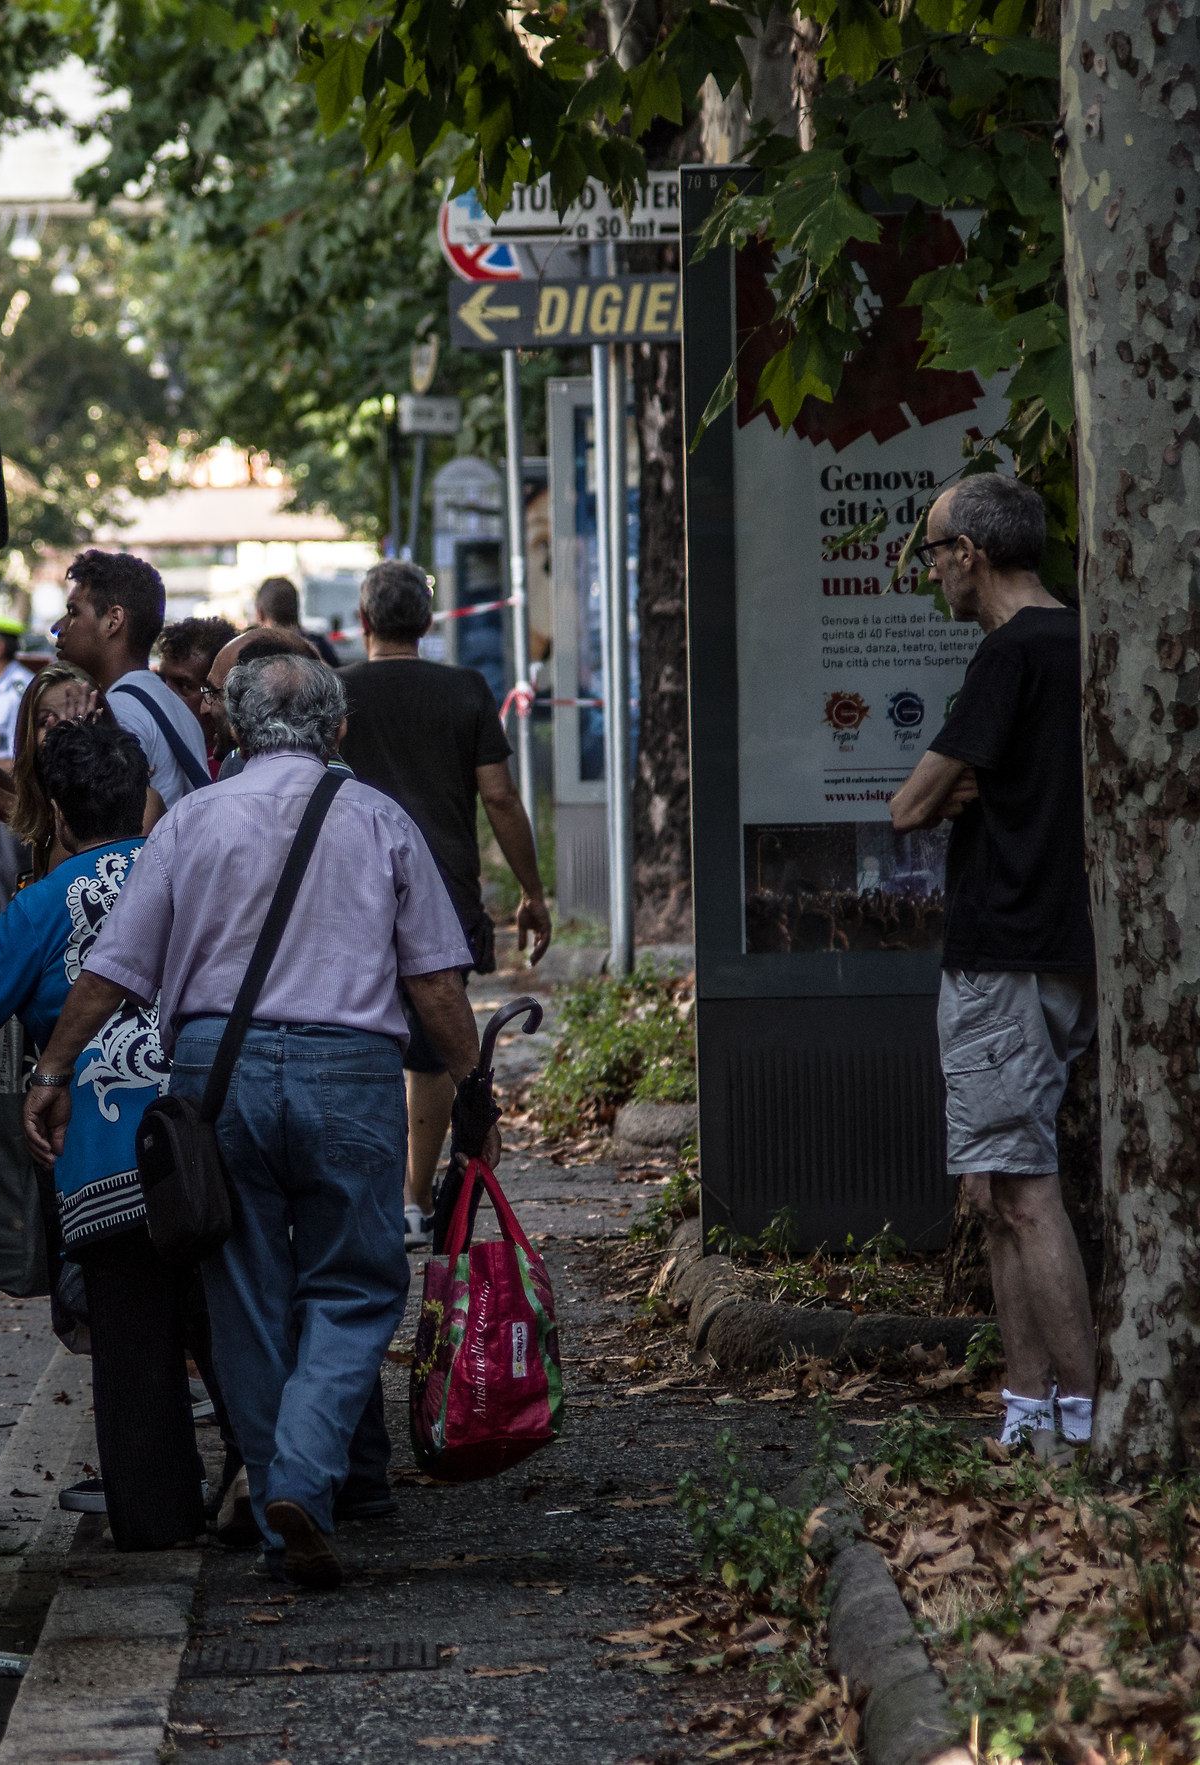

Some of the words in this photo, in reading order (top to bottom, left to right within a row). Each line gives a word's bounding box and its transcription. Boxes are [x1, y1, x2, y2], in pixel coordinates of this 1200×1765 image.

[597, 216, 620, 238] 30
[629, 220, 655, 237] mt
[533, 282, 681, 338] DIGIE
[821, 465, 935, 491] Genova
[821, 498, 888, 526] città
[822, 577, 880, 596] una
[822, 615, 860, 625] Genova
[872, 614, 881, 624] la
[884, 613, 907, 624] città
[910, 613, 926, 623] dei
[822, 629, 855, 642] quinta
[858, 629, 867, 639] di
[870, 628, 883, 639] 40
[885, 627, 925, 638] Festival
[928, 629, 947, 638] con
[950, 629, 969, 637] una
[822, 644, 863, 655] musica,
[866, 643, 900, 654] danza,
[903, 643, 937, 652] teatro,
[822, 658, 843, 669] Una
[846, 657, 869, 668] città
[872, 657, 891, 667] che
[893, 656, 921, 667] torna
[470, 1337, 486, 1372] nella
[472, 1375, 488, 1421] Artisti
